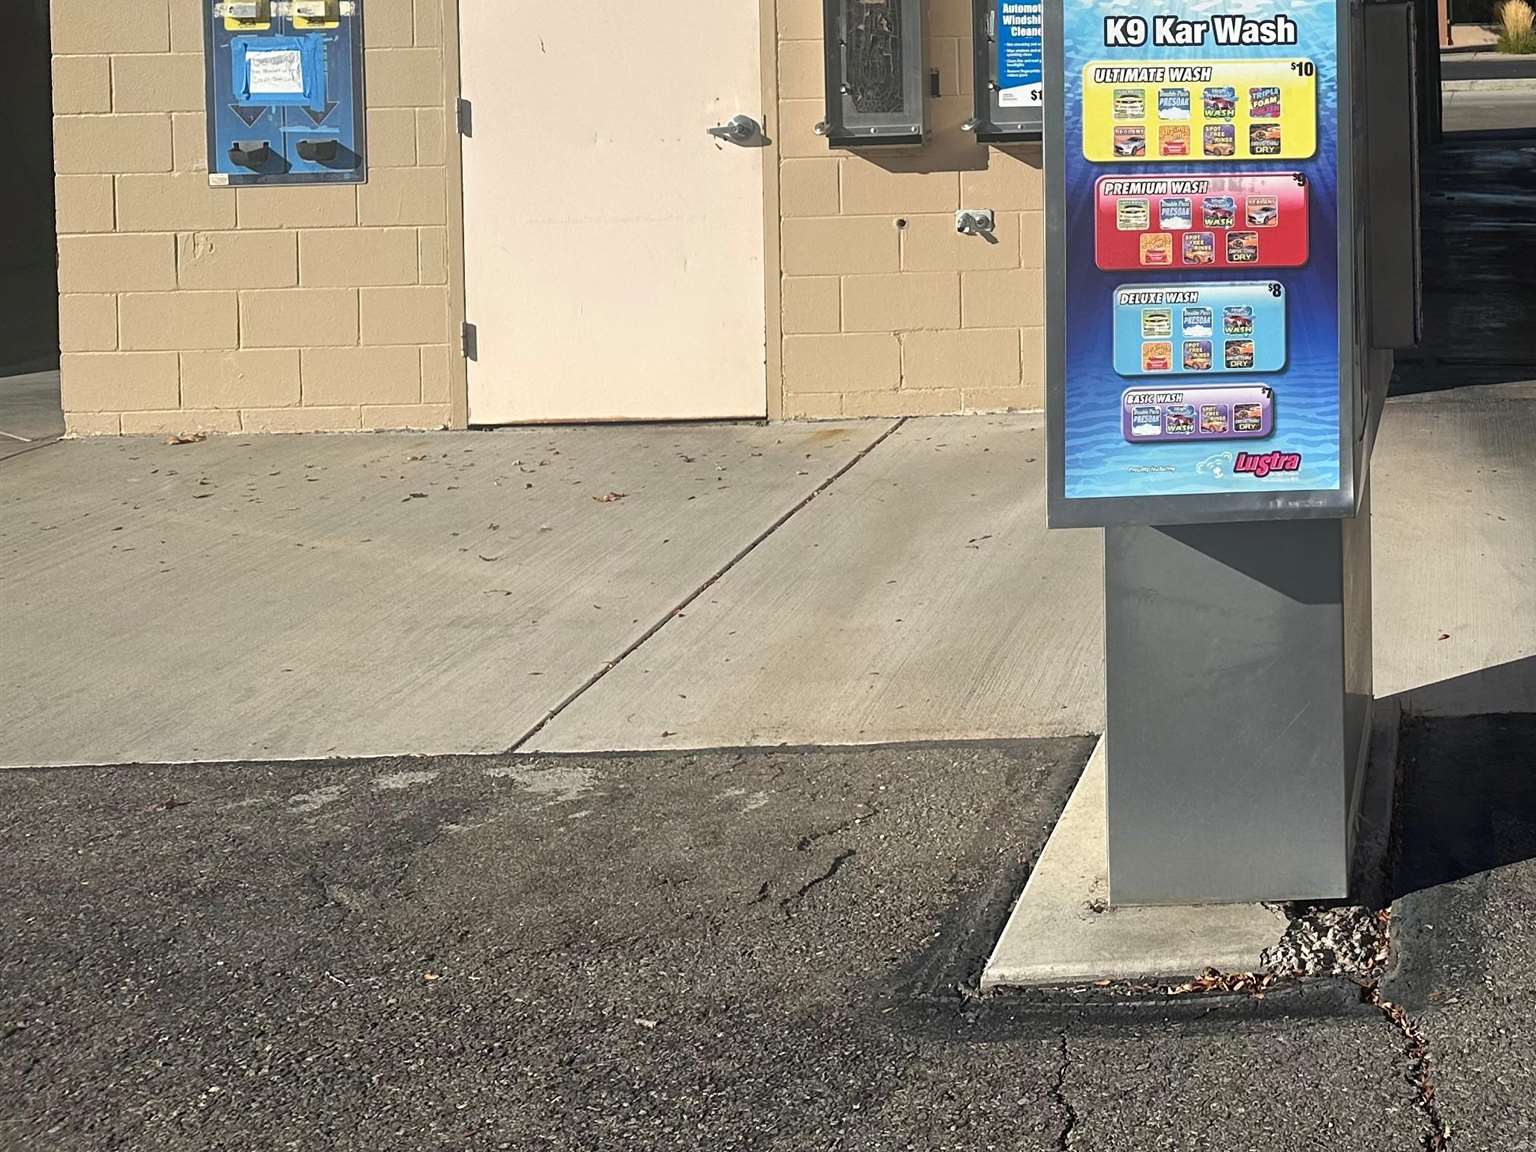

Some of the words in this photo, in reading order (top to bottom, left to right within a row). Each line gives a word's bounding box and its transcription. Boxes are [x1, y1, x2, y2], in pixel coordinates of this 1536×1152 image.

[1104, 15, 1147, 47] K9
[1154, 15, 1209, 46] Kar
[1211, 14, 1297, 46] Wash
[1094, 67, 1164, 83] ULTIMATE
[1167, 66, 1212, 83] WASH
[1291, 61, 1313, 77] $10
[1104, 181, 1168, 195] PREMIUM
[1171, 181, 1208, 194] WASH
[1120, 292, 1163, 305] DELUXE
[1165, 291, 1199, 304] WASH
[1268, 283, 1281, 297] $8
[1127, 394, 1154, 404] BASIC
[1156, 393, 1183, 403] WASH
[1262, 387, 1272, 398] $7
[1233, 450, 1302, 478] Lustra
